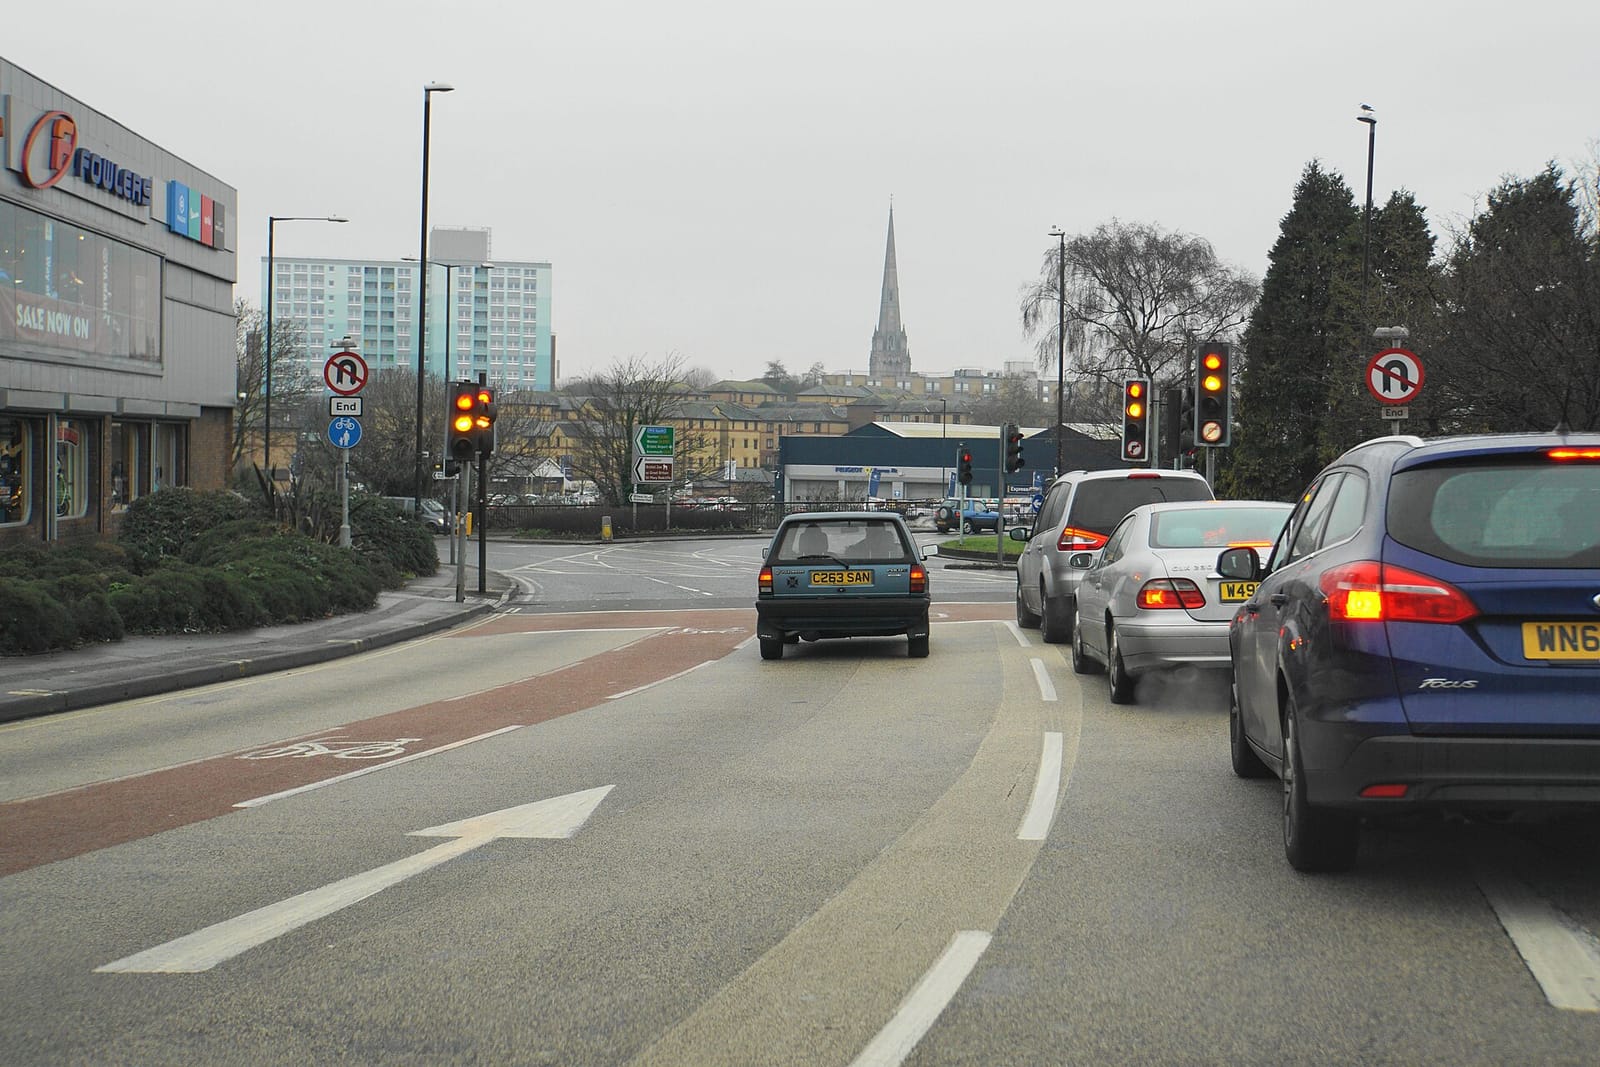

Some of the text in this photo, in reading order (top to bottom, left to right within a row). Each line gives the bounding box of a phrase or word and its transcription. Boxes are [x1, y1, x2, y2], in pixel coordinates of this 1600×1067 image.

[76, 147, 152, 206] FOWLERS
[16, 303, 89, 340] SALE NOW ON
[336, 402, 357, 411] End
[1385, 408, 1403, 417] End
[812, 572, 870, 583] C263 SAN
[1226, 583, 1260, 598] W49
